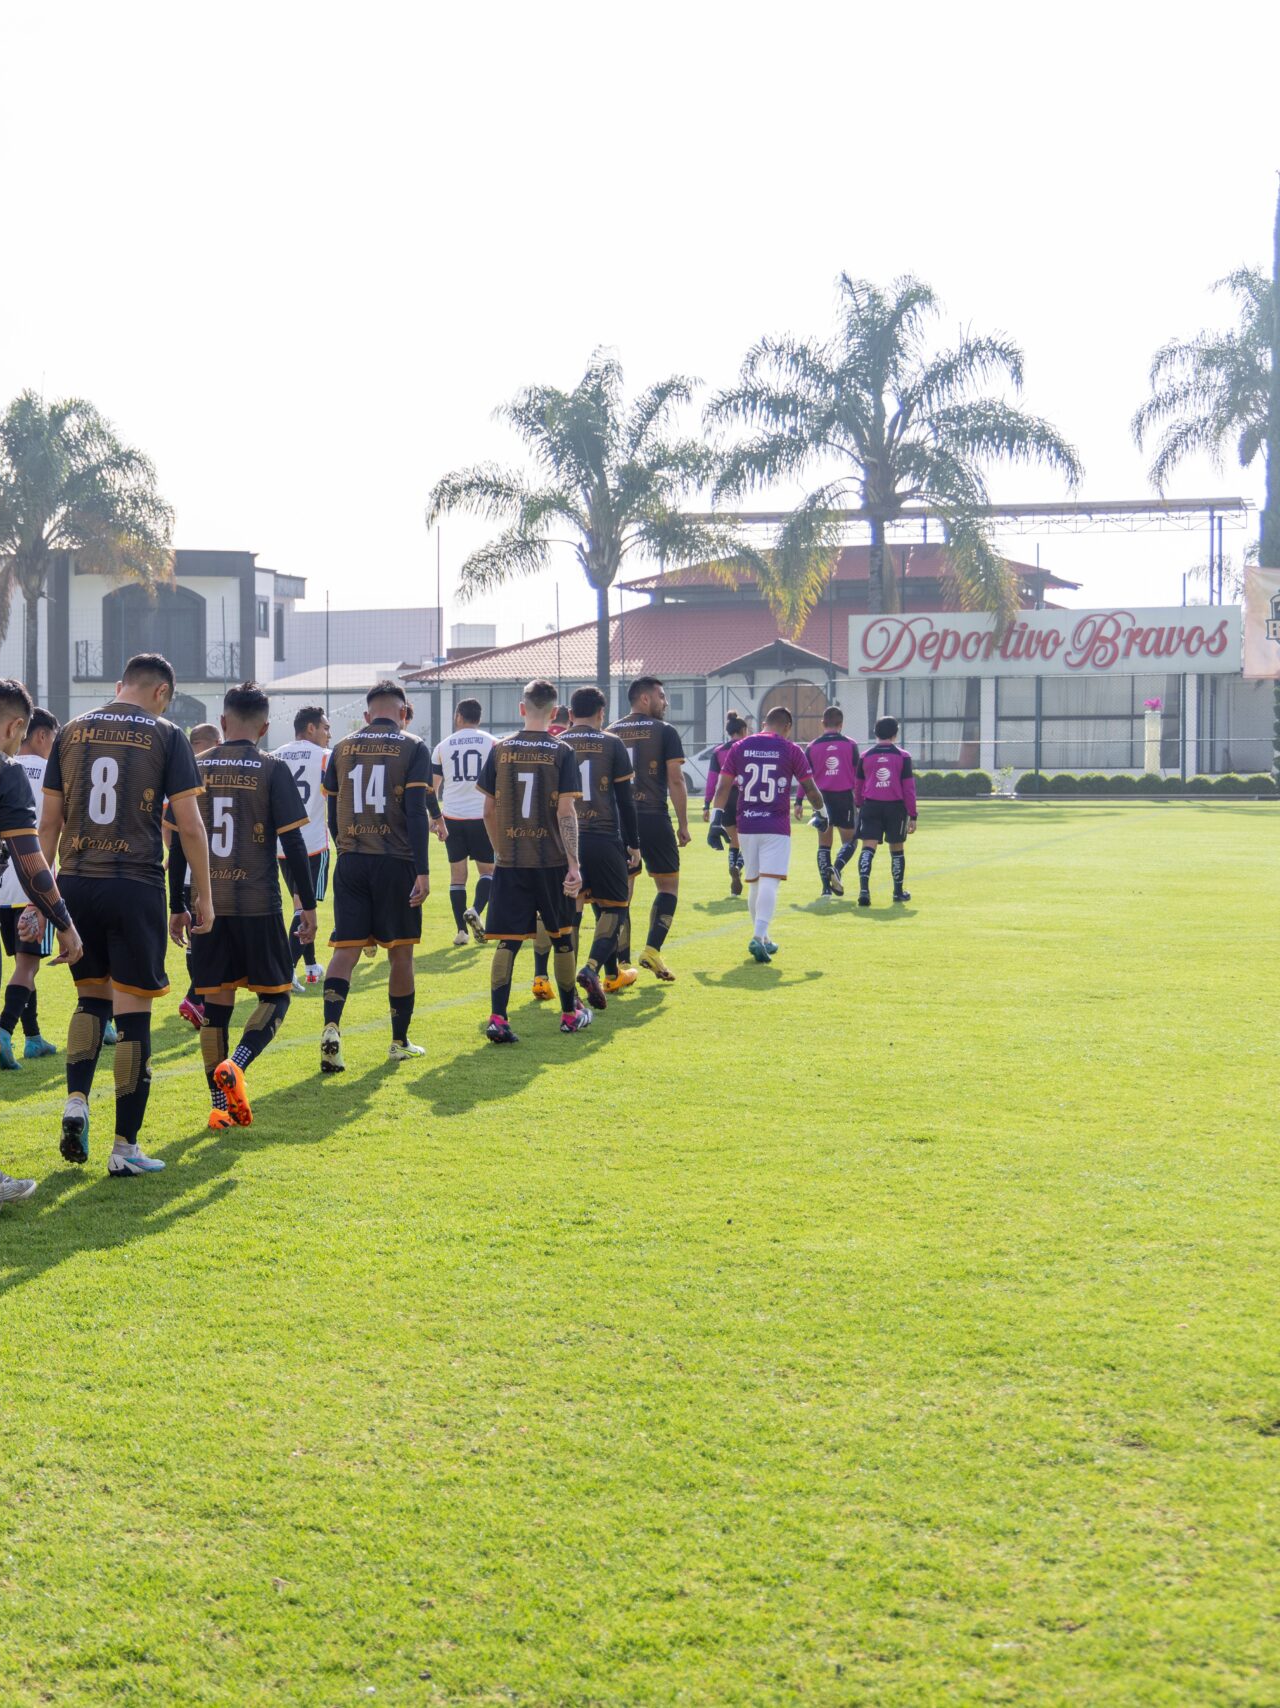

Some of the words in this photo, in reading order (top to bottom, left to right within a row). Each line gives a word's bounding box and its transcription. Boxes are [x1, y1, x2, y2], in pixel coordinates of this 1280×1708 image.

[859, 617, 1065, 673] Deportivo
[1065, 611, 1228, 669] Bravos
[76, 713, 157, 726] CORONADO
[347, 733, 406, 741] CORONADO
[502, 740, 559, 749] CORONADO
[196, 759, 262, 769] CORONADO
[450, 749, 483, 782] 10
[88, 756, 119, 825] 8
[203, 774, 258, 787] HFITNESS
[348, 764, 387, 814] 14
[744, 763, 777, 803] 25
[139, 800, 153, 813] LG
[518, 773, 534, 819] 7
[211, 796, 234, 858] 5
[252, 833, 265, 844] LG
